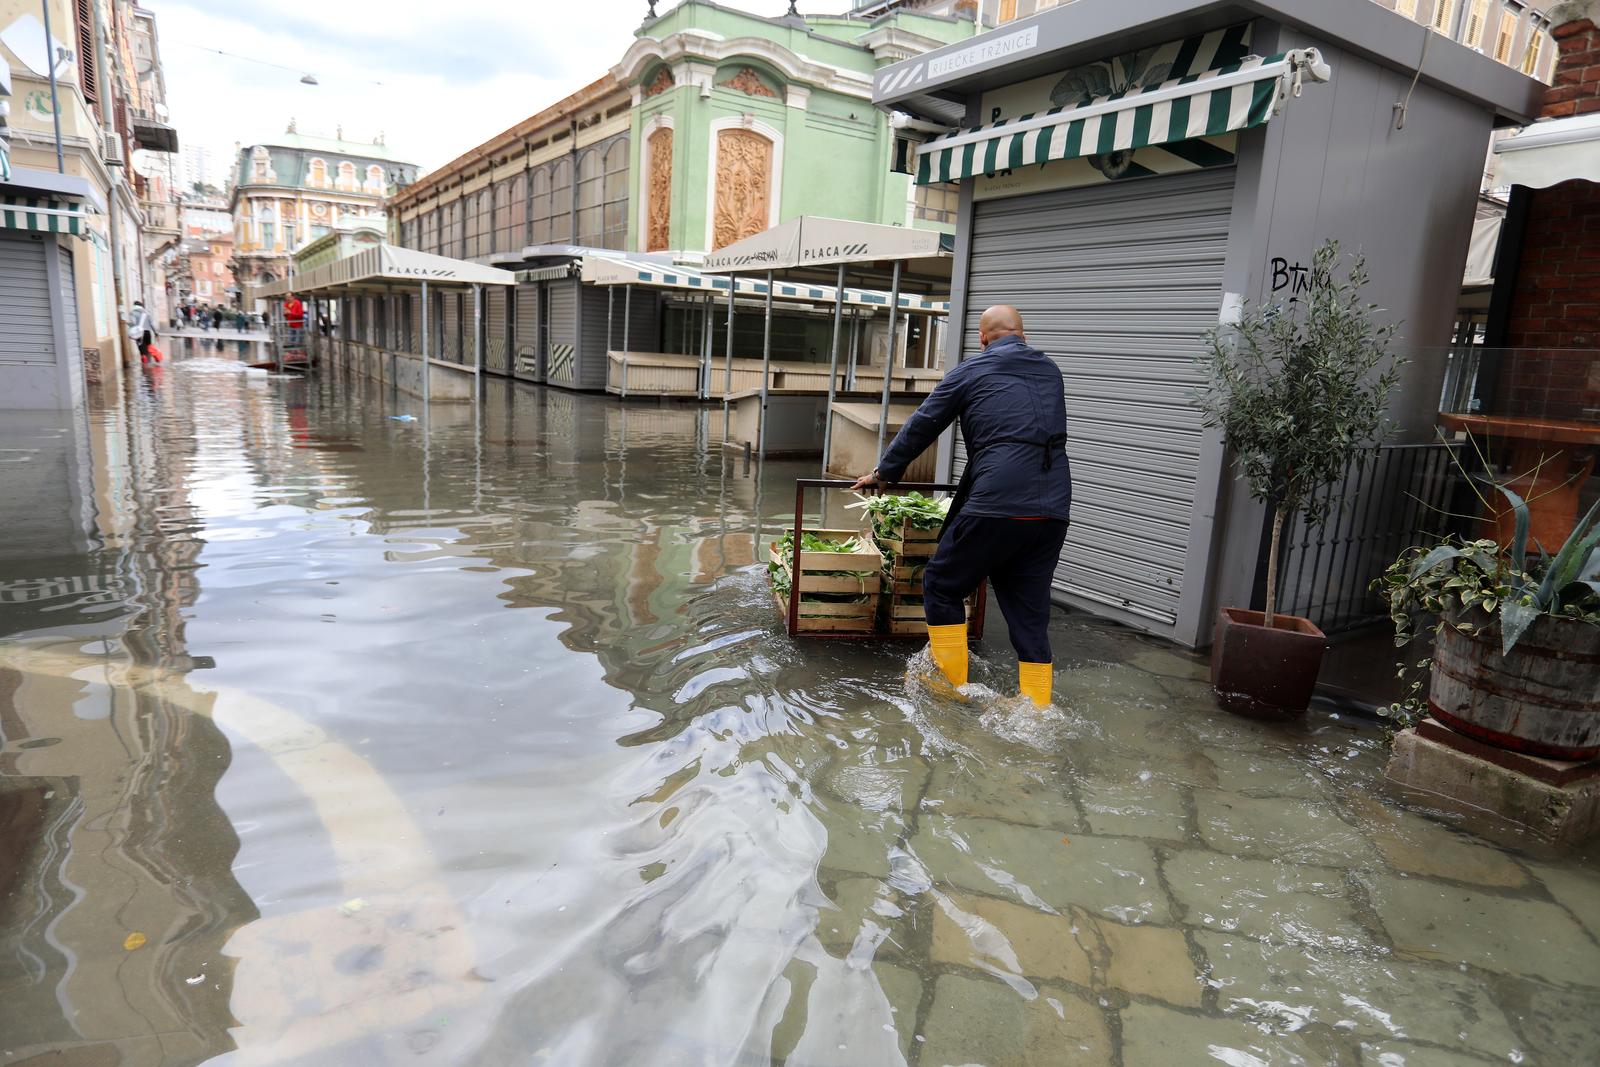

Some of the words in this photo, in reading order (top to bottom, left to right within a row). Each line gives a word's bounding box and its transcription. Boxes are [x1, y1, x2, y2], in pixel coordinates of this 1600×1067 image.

[932, 51, 975, 75] RIJEČKE
[981, 33, 1032, 59] TRŽNICE
[804, 245, 839, 259] PLACA
[705, 256, 731, 267] PLACA
[388, 266, 427, 275] PLACA
